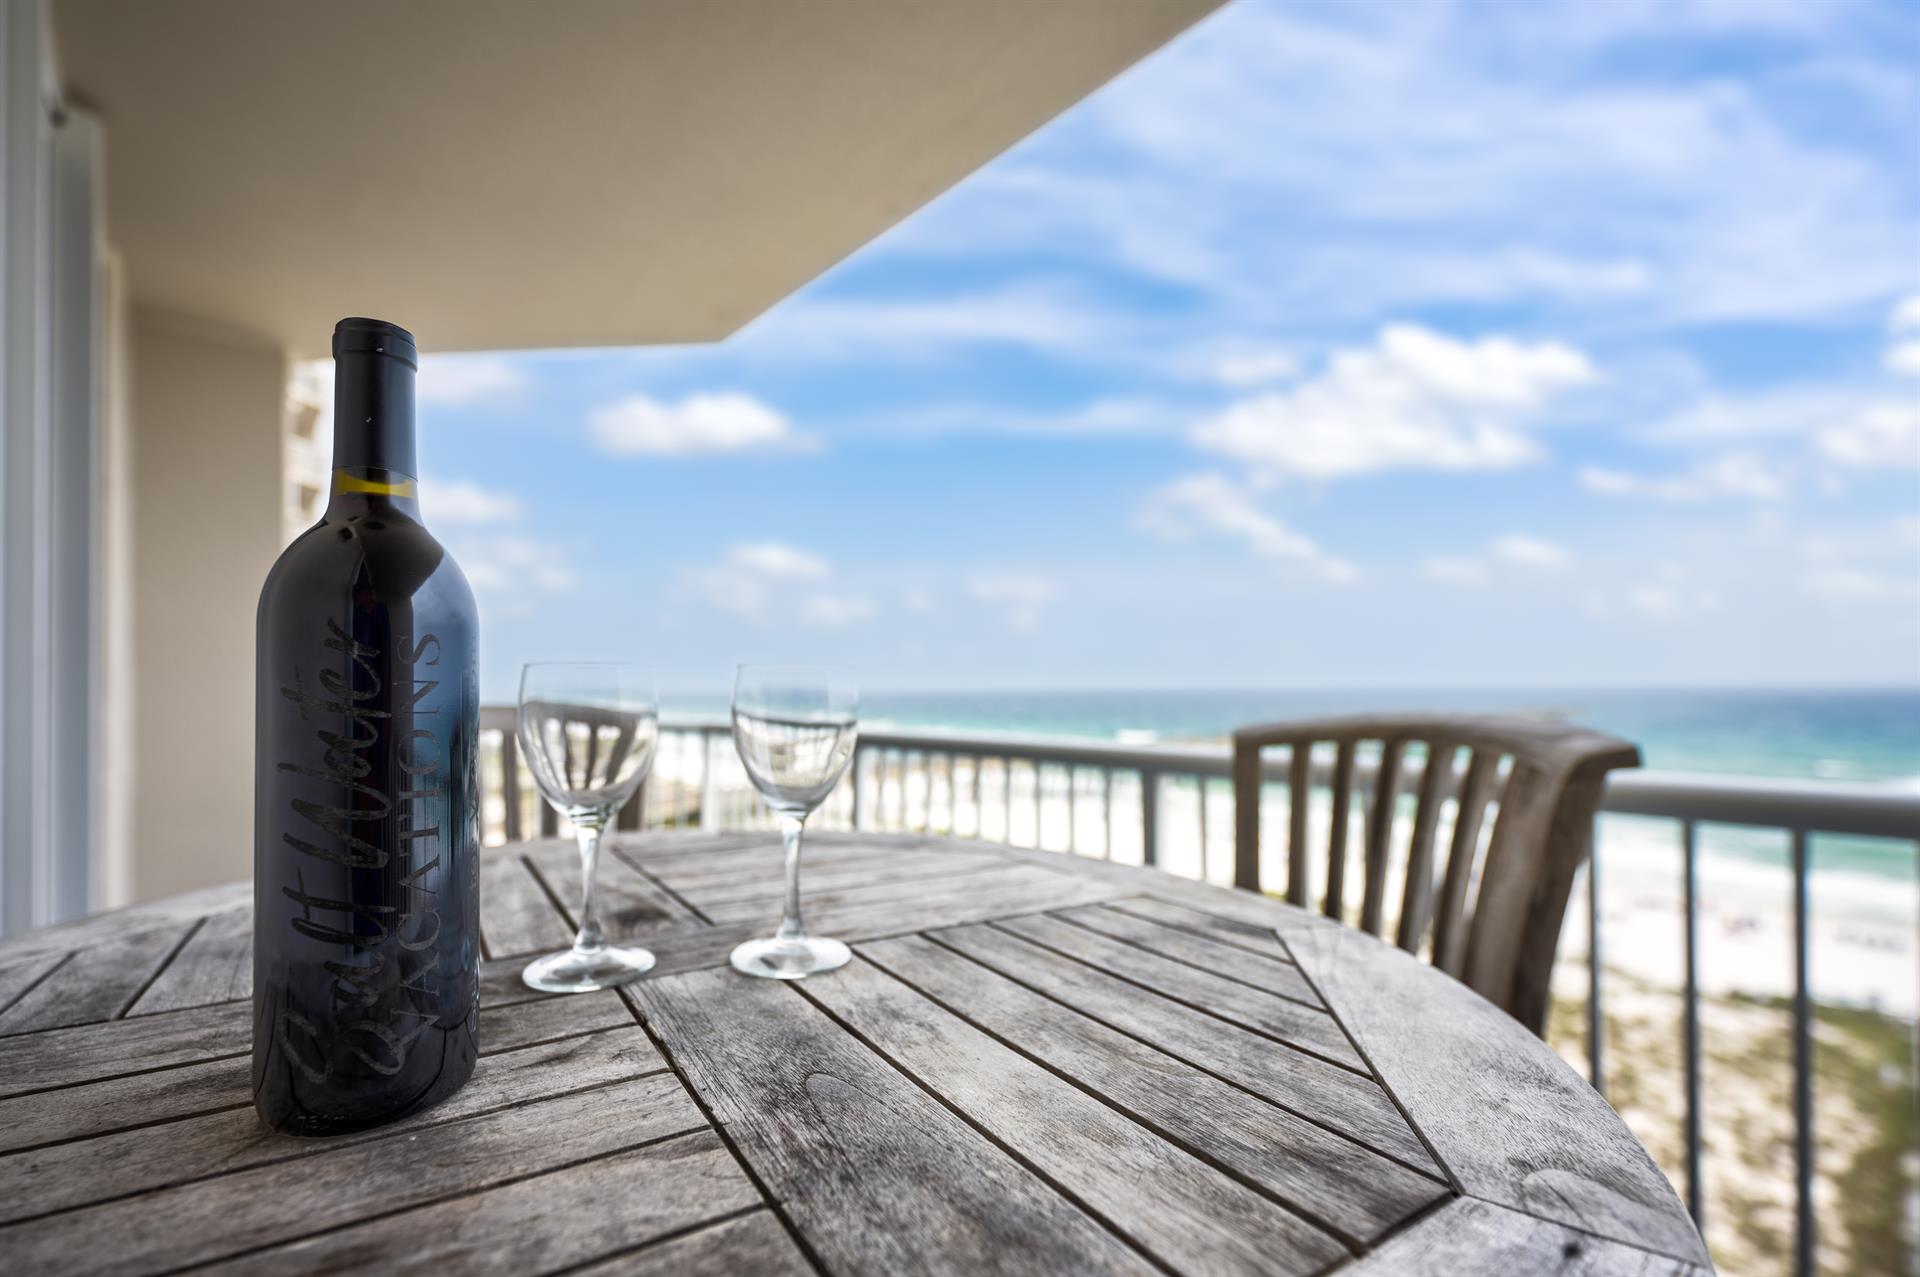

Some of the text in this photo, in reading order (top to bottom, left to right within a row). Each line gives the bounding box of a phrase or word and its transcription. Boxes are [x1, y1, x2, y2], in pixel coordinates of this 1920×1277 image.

[277, 616, 406, 1084] Salt Water
[390, 632, 442, 1052] VACATIONS
